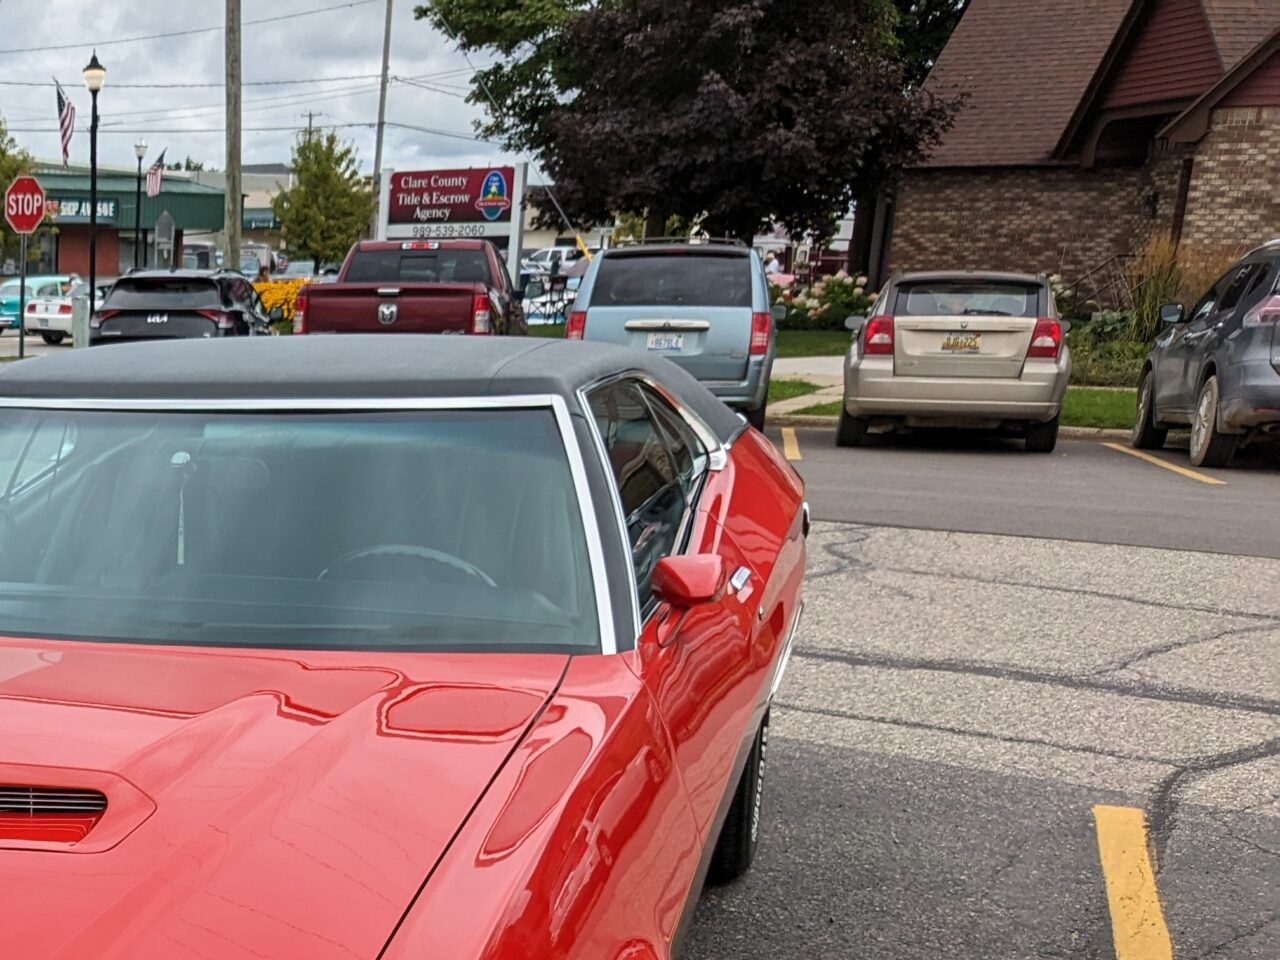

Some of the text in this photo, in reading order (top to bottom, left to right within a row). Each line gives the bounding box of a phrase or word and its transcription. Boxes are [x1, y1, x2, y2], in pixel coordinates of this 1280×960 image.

[401, 175, 468, 189] Clare County
[8, 194, 42, 215] STOP
[397, 193, 421, 206] Title
[422, 193, 430, 205] &
[432, 192, 471, 204] Escrow
[413, 207, 451, 221] Agency
[412, 225, 485, 237] 989-539-2060
